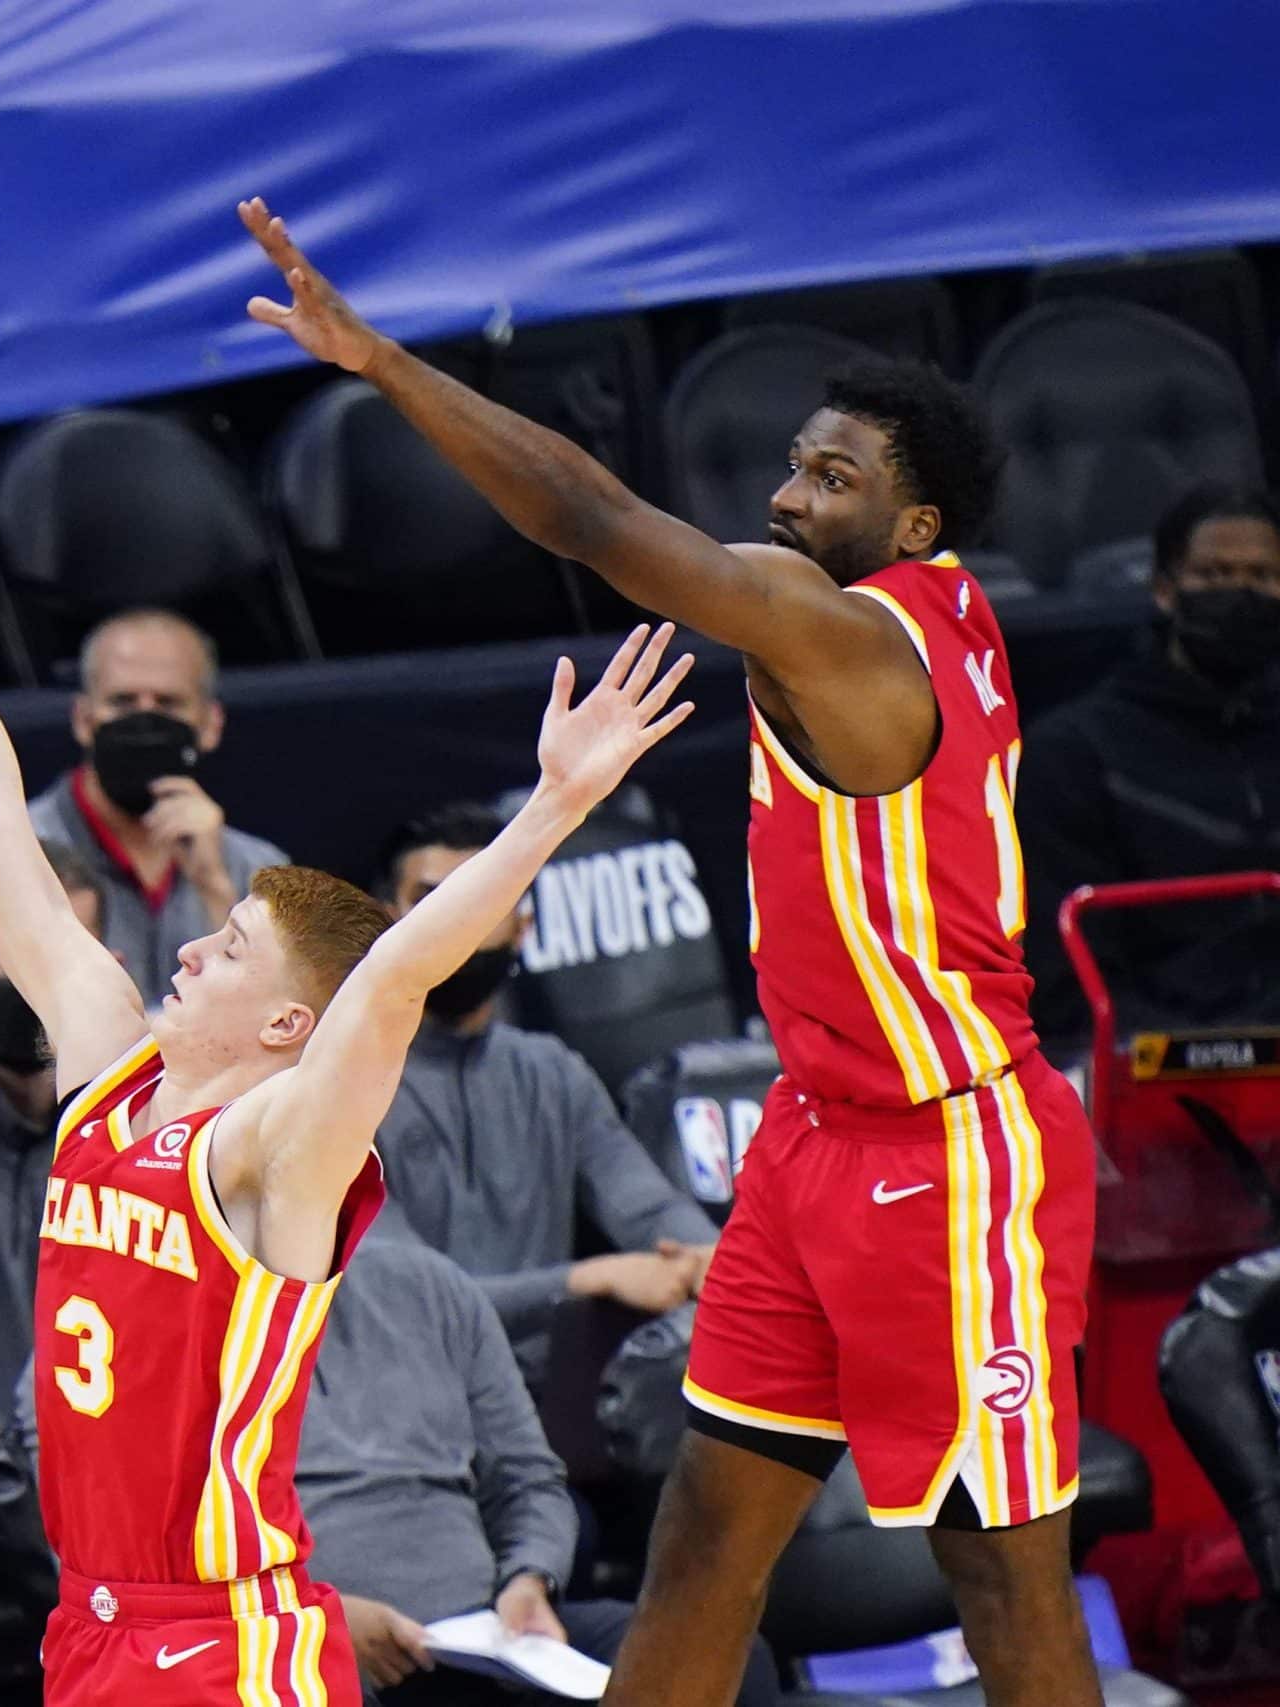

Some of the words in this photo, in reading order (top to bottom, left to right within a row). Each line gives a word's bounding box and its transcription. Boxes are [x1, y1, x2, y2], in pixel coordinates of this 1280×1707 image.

[518, 839, 712, 973] LAYOFFS
[39, 1176, 199, 1282] LANTA
[53, 1294, 115, 1419] 3
